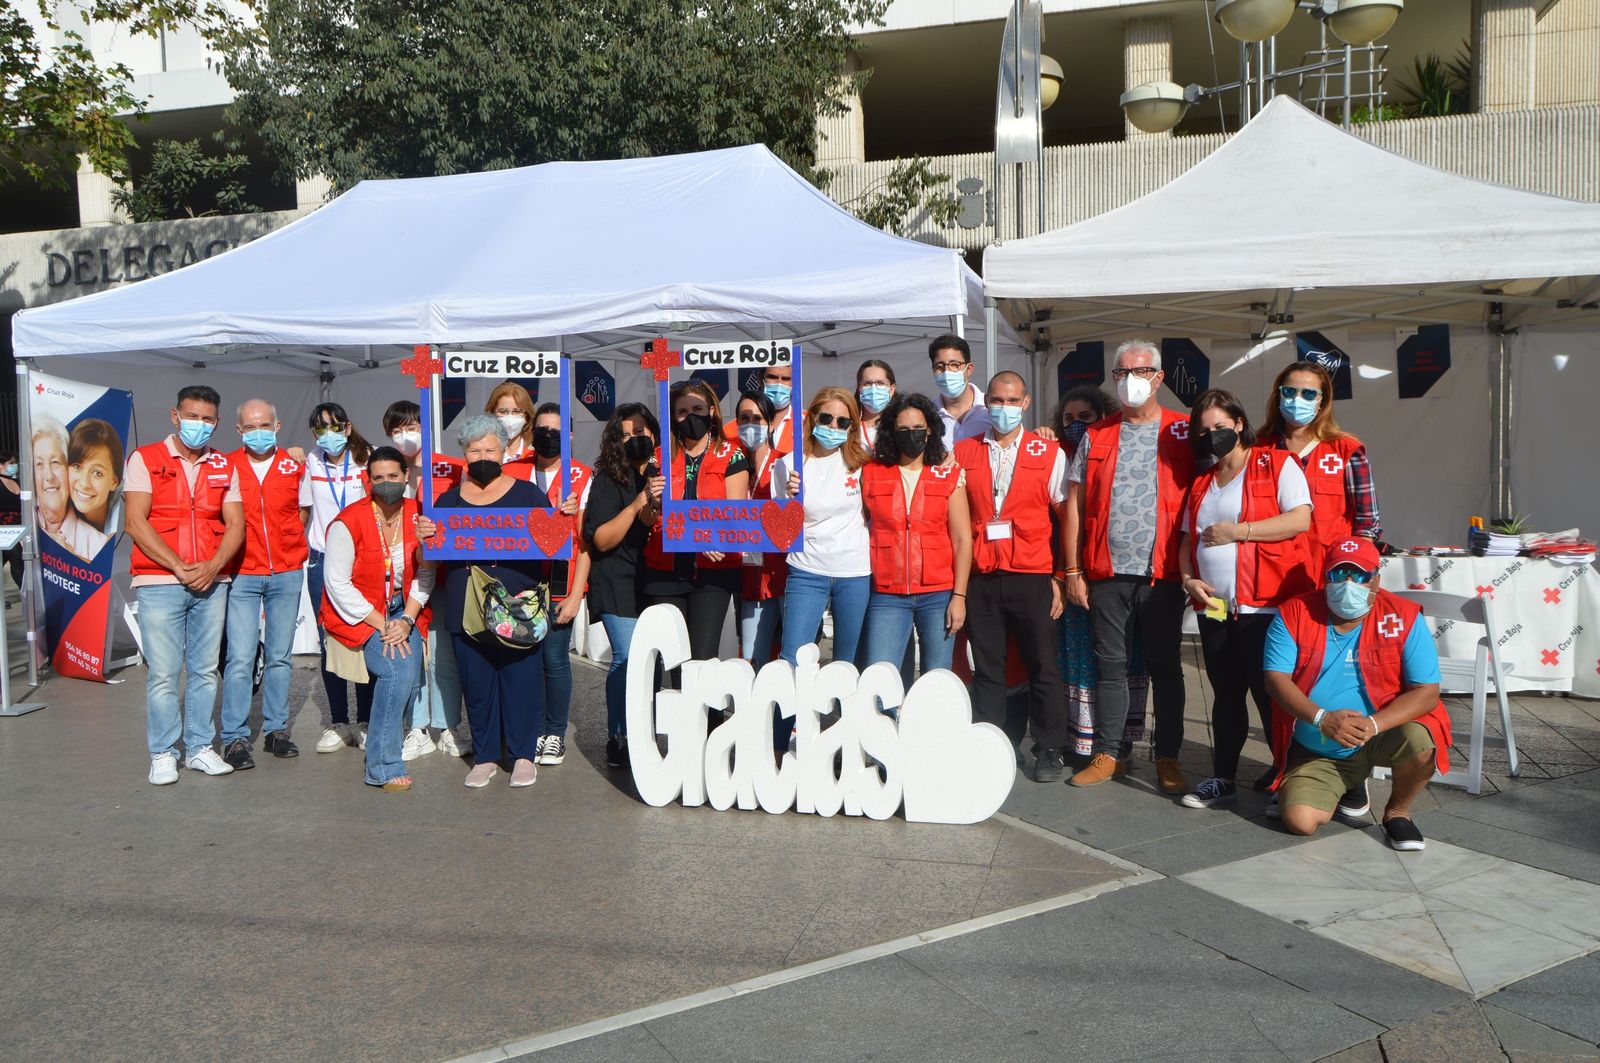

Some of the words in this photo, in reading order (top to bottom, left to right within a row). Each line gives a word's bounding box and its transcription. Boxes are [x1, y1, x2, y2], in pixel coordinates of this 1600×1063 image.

[685, 348, 735, 365] Cruz
[739, 341, 791, 365] Roja
[448, 356, 499, 373] Cruz
[505, 353, 558, 376] Roja
[47, 387, 61, 396] Cruz
[61, 390, 75, 399] Roja
[448, 514, 526, 530] GRACIAS
[688, 506, 761, 521] GRACIAS
[454, 535, 476, 551] DE
[482, 536, 530, 552] TODO
[693, 528, 712, 543] DE
[717, 529, 762, 544] TODO
[42, 552, 70, 573] BOTÓN
[72, 566, 103, 585] ROJO
[1424, 570, 1441, 584] Cruz
[1437, 559, 1454, 573] Roja
[1492, 572, 1509, 587] Cruz
[1505, 560, 1523, 575] Roja
[43, 567, 81, 595] PROTEGE
[1437, 619, 1455, 634] Roja
[1505, 623, 1523, 638] Roja
[90, 655, 100, 665] 87
[625, 603, 904, 821] Gracias
